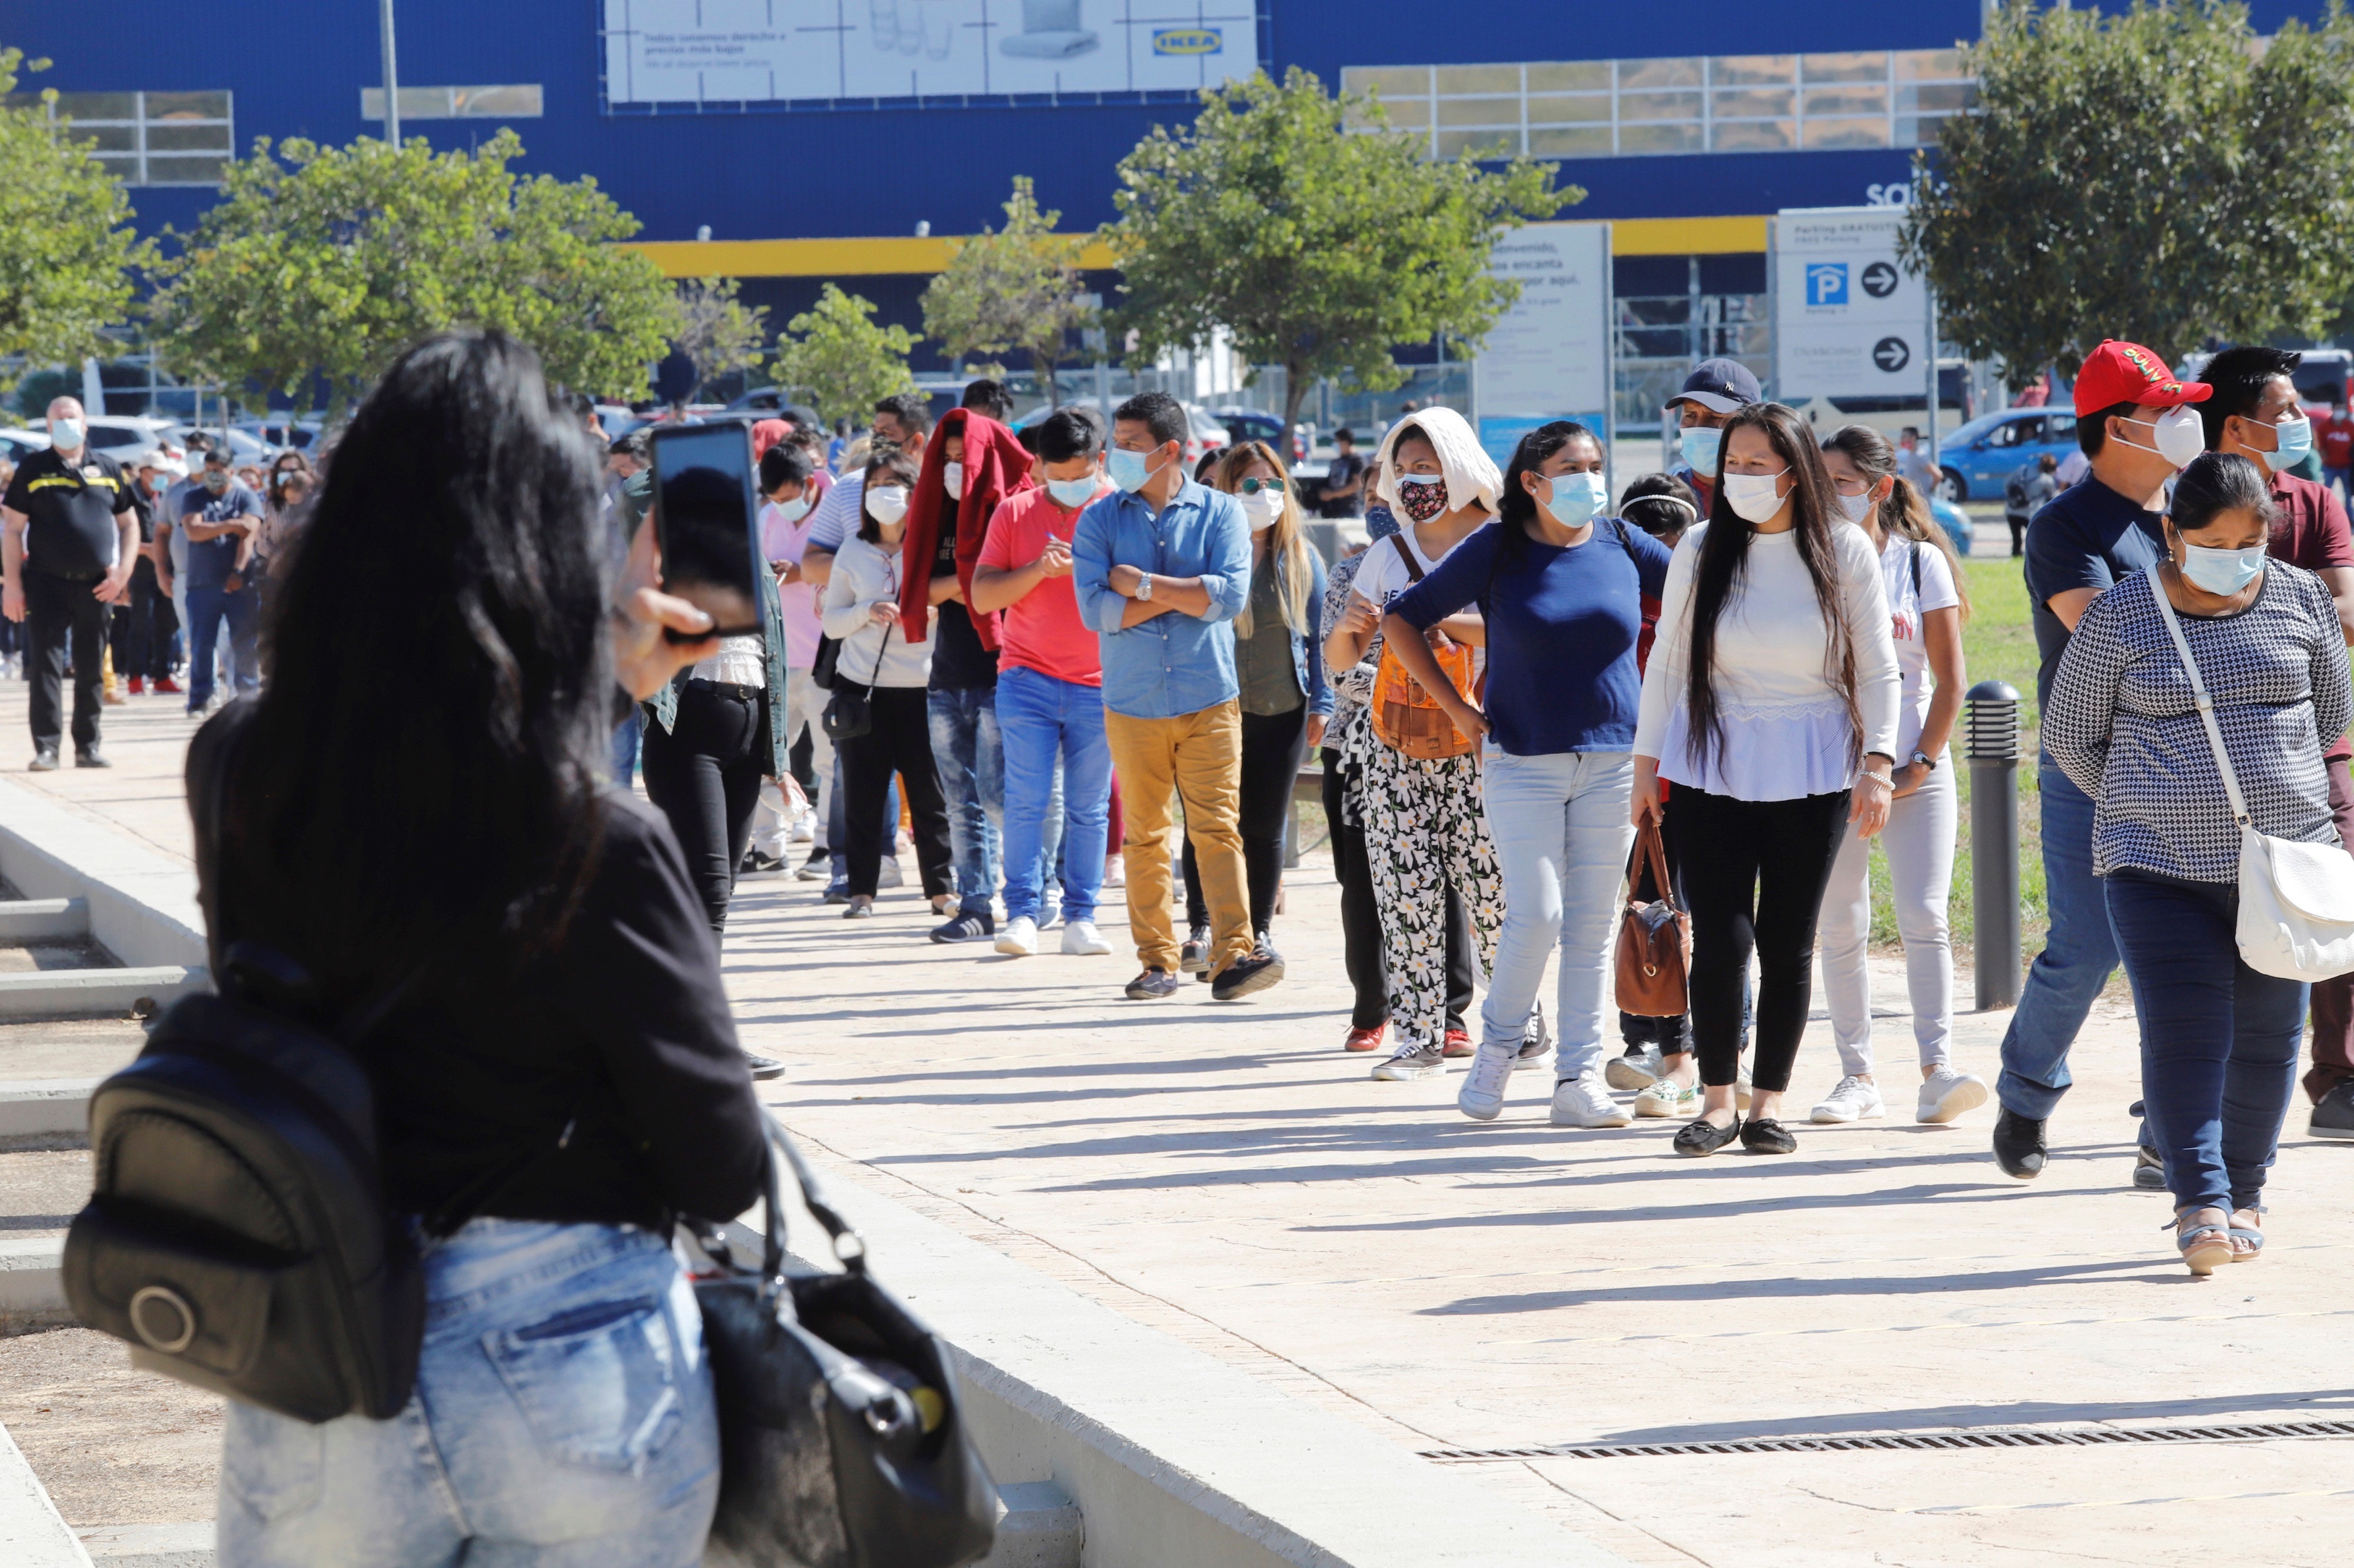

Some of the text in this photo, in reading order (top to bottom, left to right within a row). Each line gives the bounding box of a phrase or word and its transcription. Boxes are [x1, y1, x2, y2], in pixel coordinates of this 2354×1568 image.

[732, 32, 776, 41] derecho
[1160, 36, 1215, 47] IKEA
[1795, 225, 1836, 235] Parking
[2122, 347, 2183, 394] BOLIVIA
[1725, 381, 1735, 391] NY
